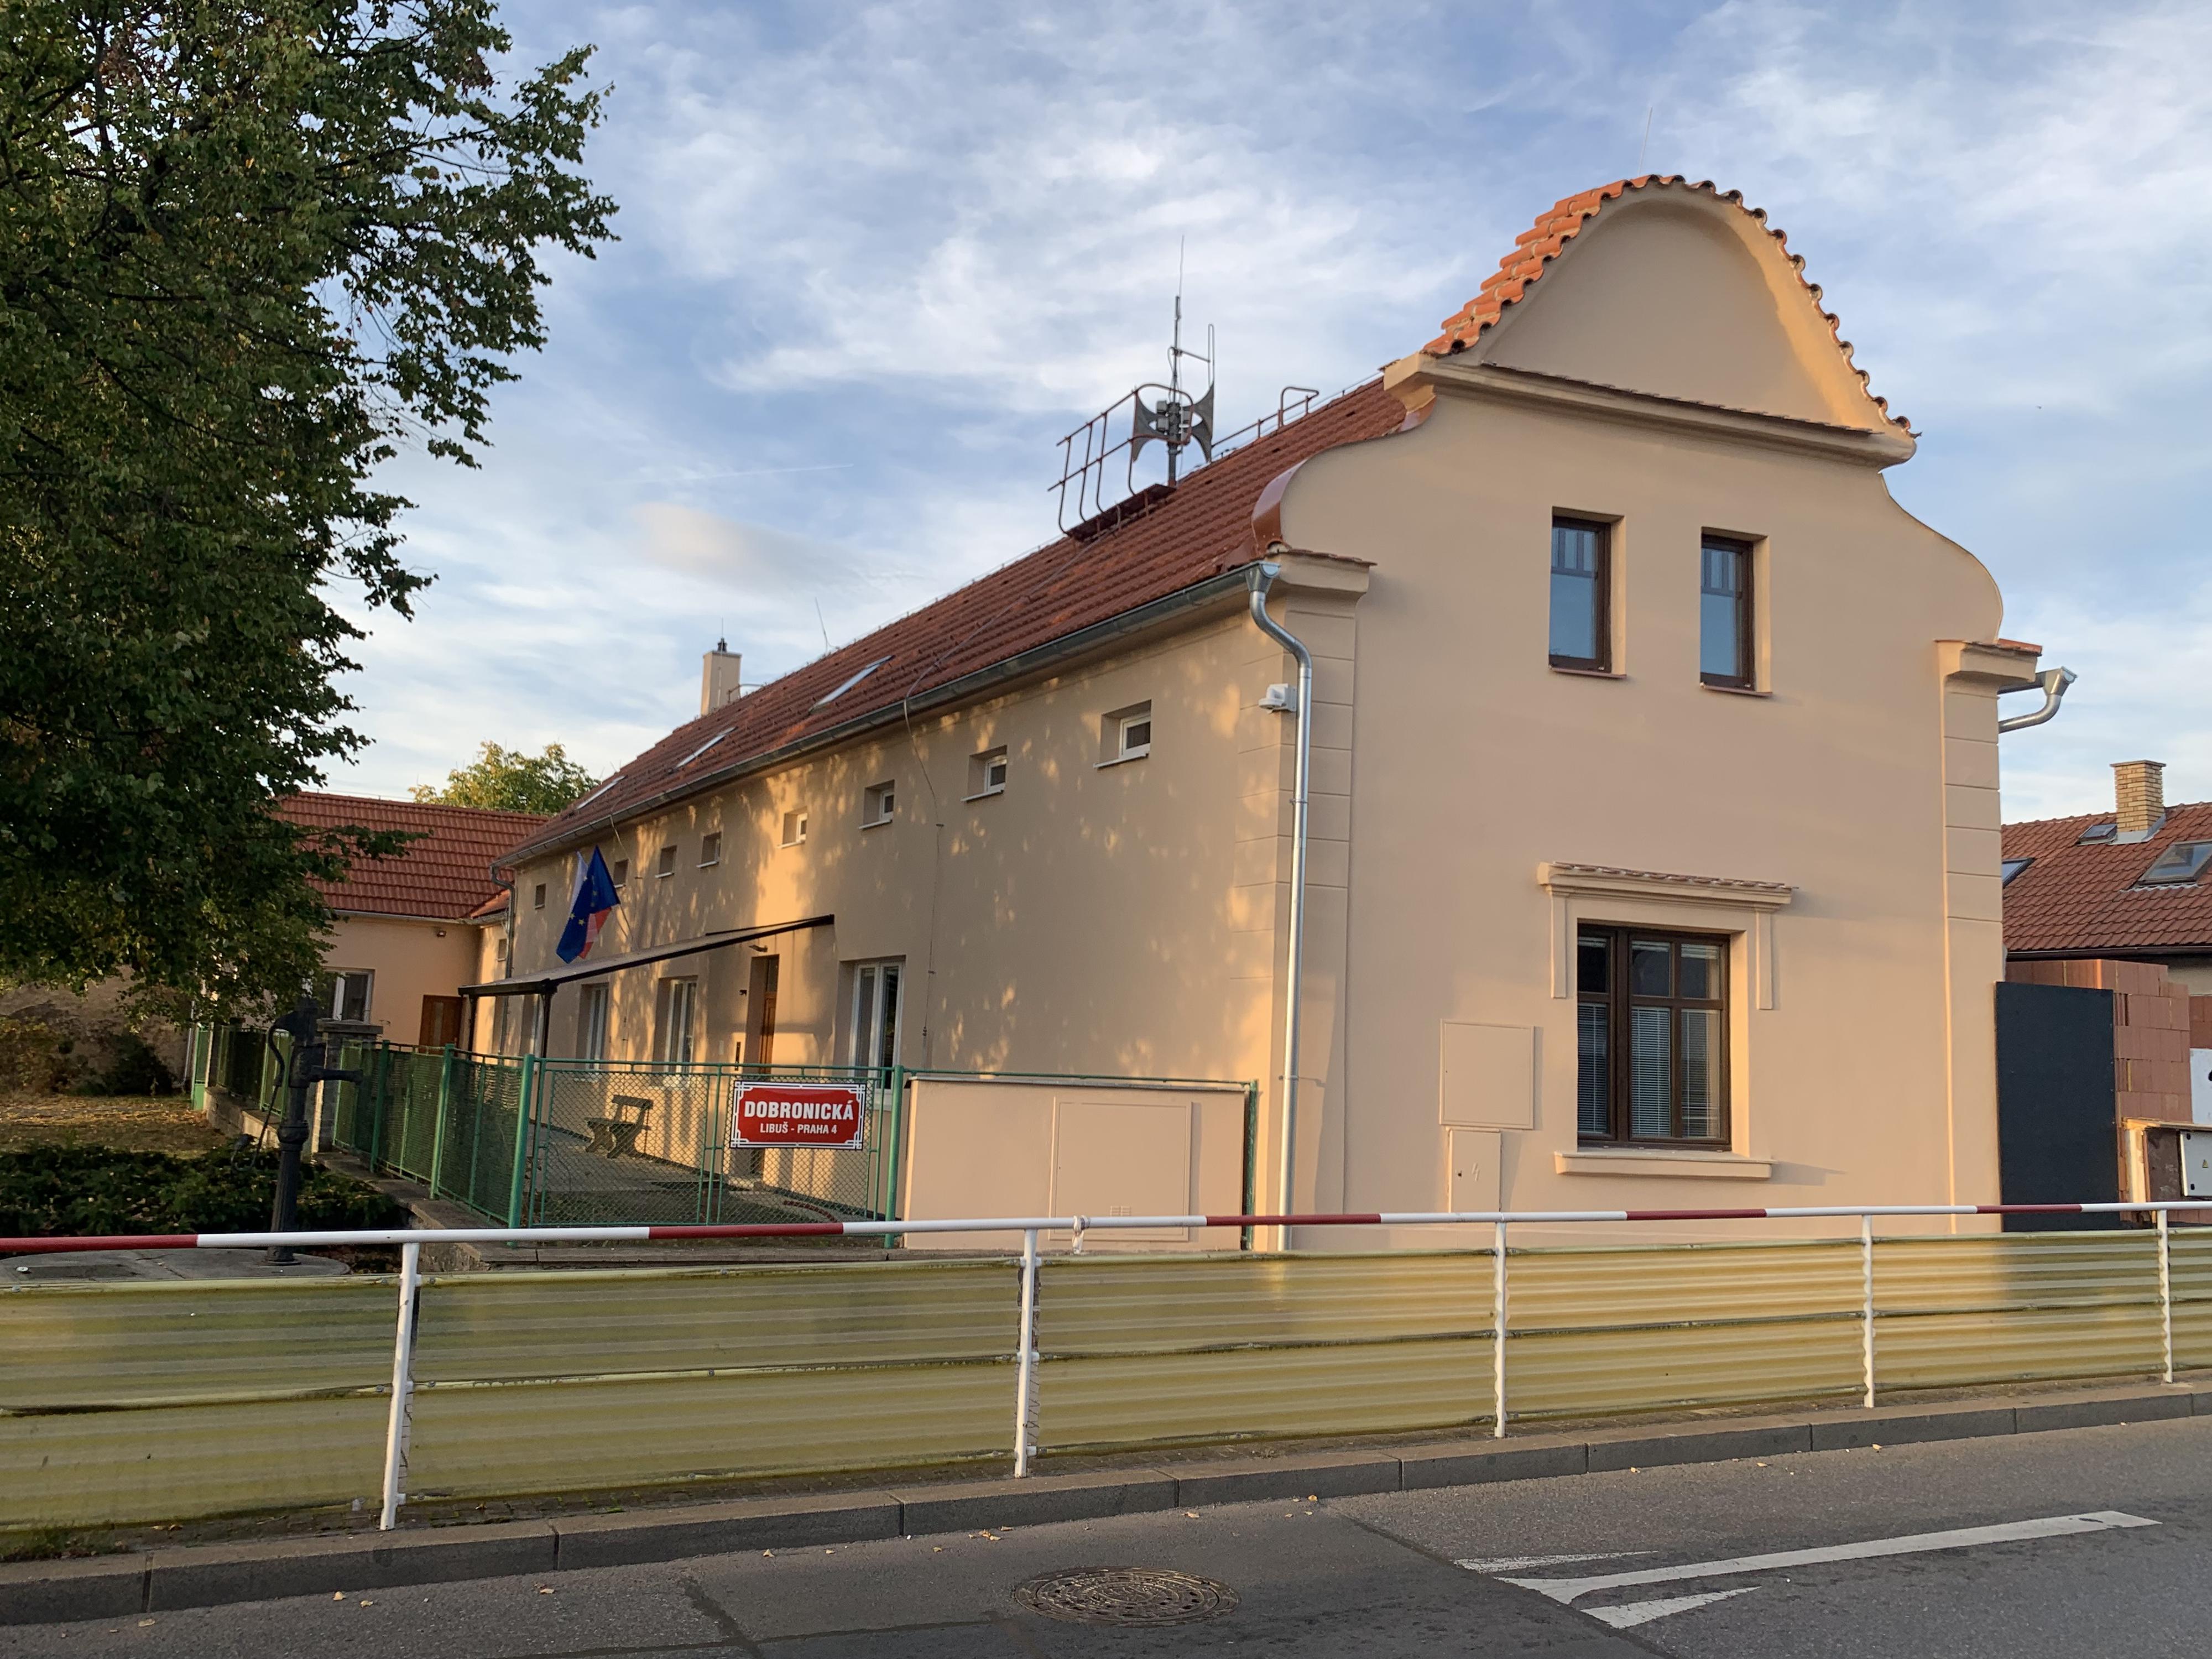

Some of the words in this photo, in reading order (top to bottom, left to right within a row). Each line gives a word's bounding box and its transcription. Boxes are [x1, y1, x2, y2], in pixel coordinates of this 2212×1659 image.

[744, 1100, 854, 1120] DOBRONICKÁ
[760, 1121, 789, 1134] LIBUŠ
[797, 1124, 830, 1134] PRAHA
[831, 1124, 838, 1134] 4
